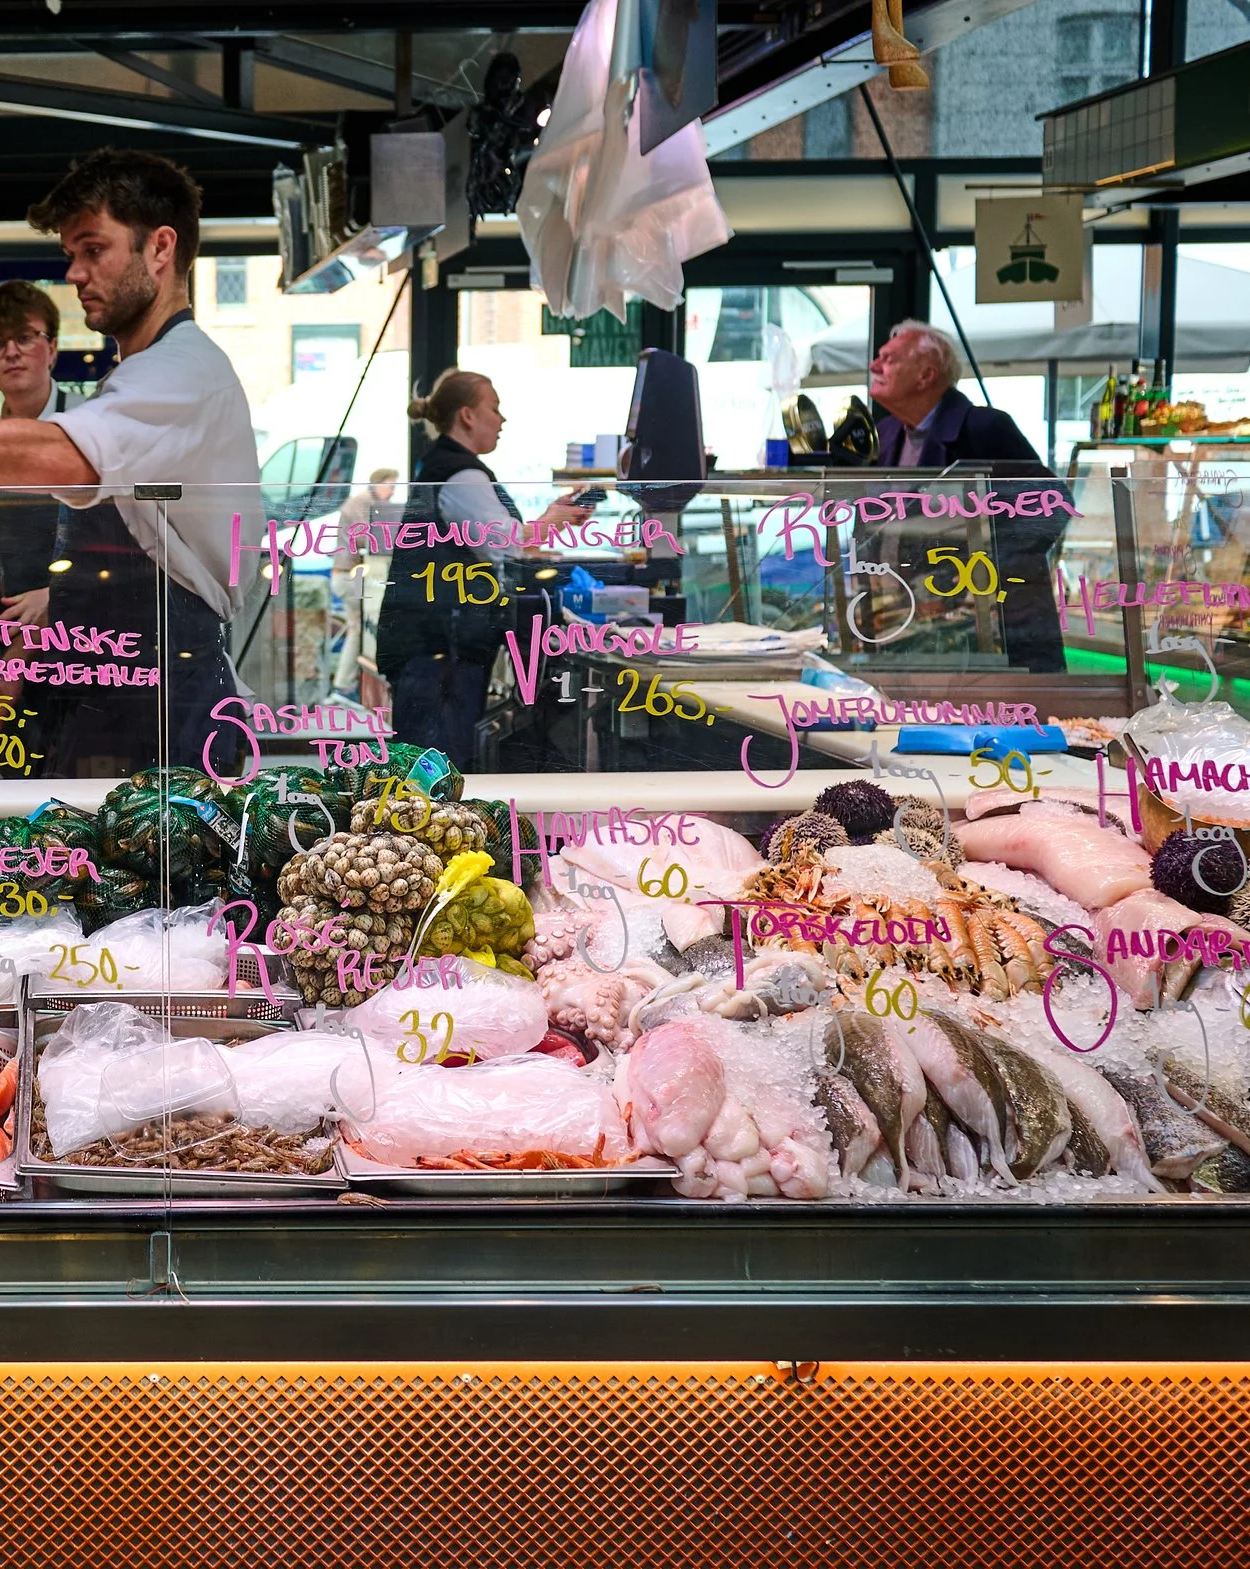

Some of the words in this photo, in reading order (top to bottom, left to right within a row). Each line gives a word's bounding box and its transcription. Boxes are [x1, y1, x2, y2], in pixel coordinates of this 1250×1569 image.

[228, 511, 687, 596] HJERTEMUSLINGER
[757, 490, 1085, 567] RØDTUNGER
[506, 613, 705, 706] VONGOLE
[202, 696, 398, 786] SASHIMI
[308, 735, 390, 769] TUN
[740, 693, 1049, 789] JOMFRUHUMMER
[509, 797, 708, 888] HAVTASKE
[336, 949, 465, 994] REJER
